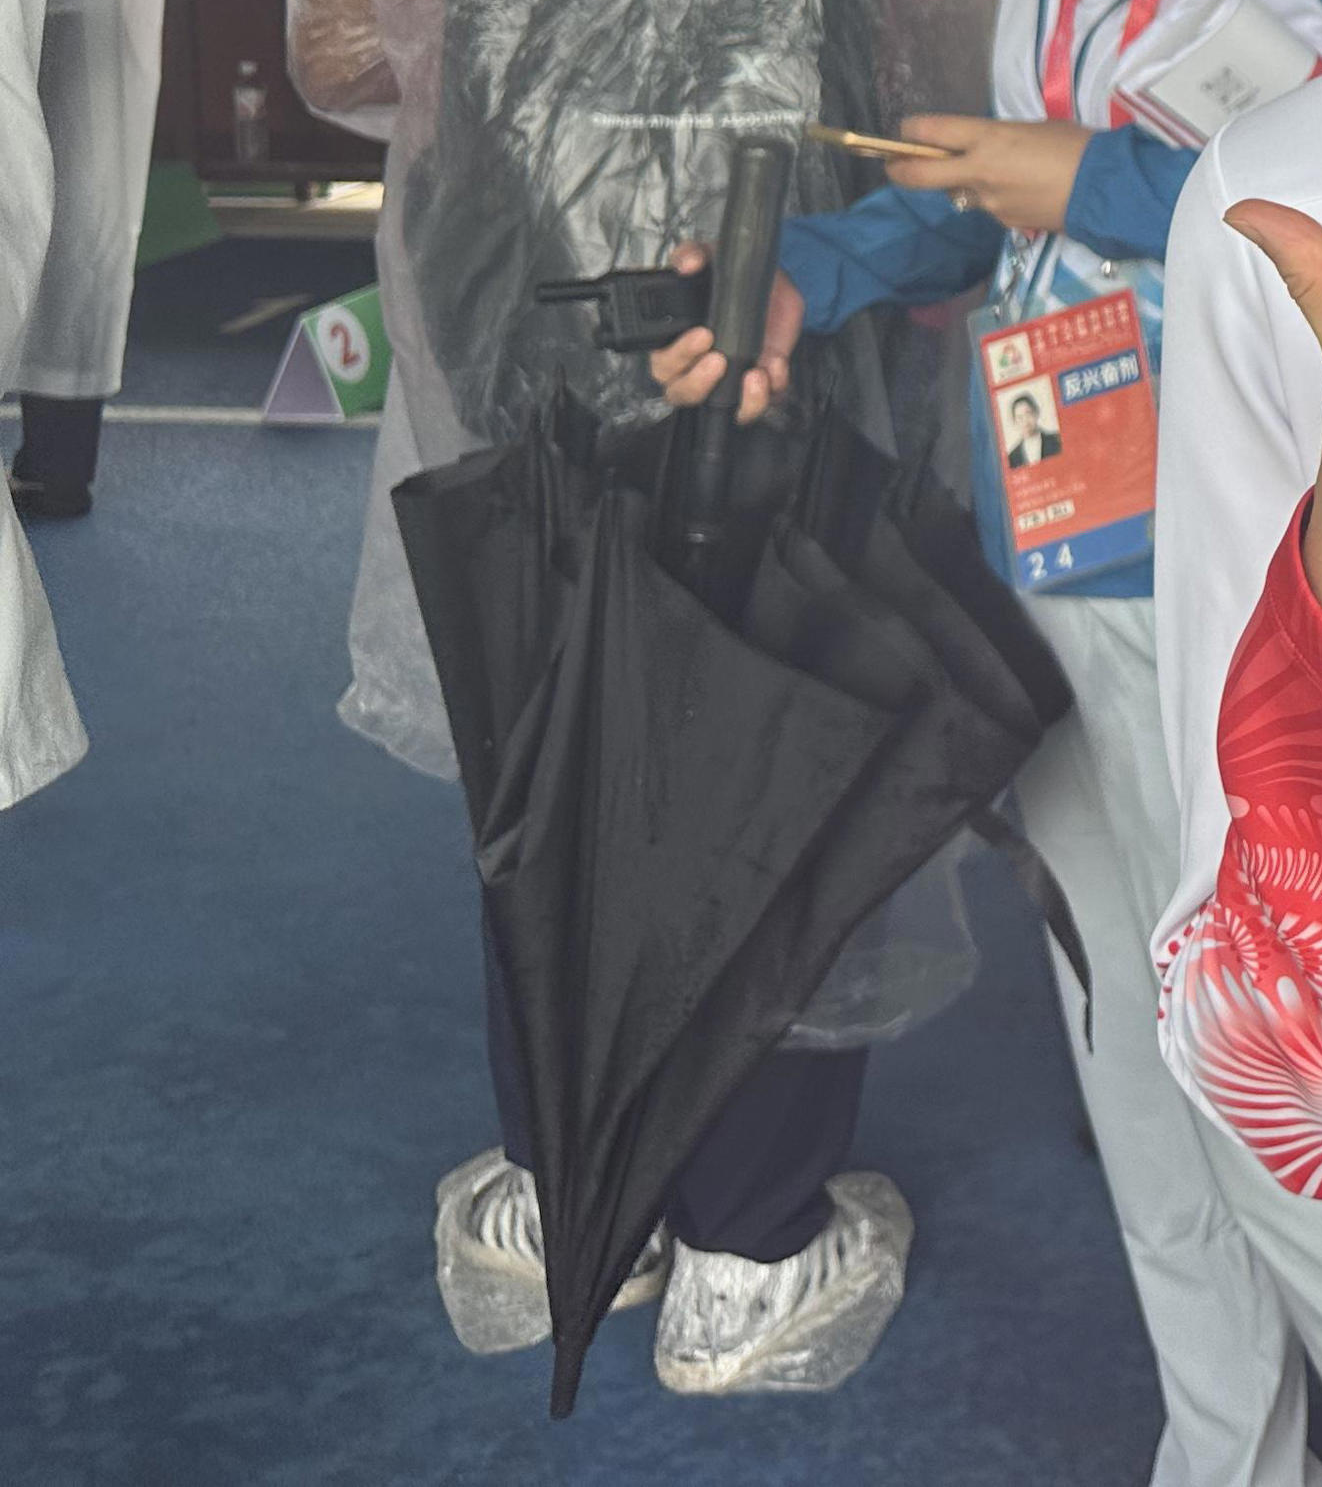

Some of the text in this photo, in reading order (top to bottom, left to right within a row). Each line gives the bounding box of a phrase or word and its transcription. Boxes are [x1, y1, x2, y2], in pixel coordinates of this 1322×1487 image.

[330, 321, 361, 366] 2
[1027, 542, 1074, 581] 2 4
